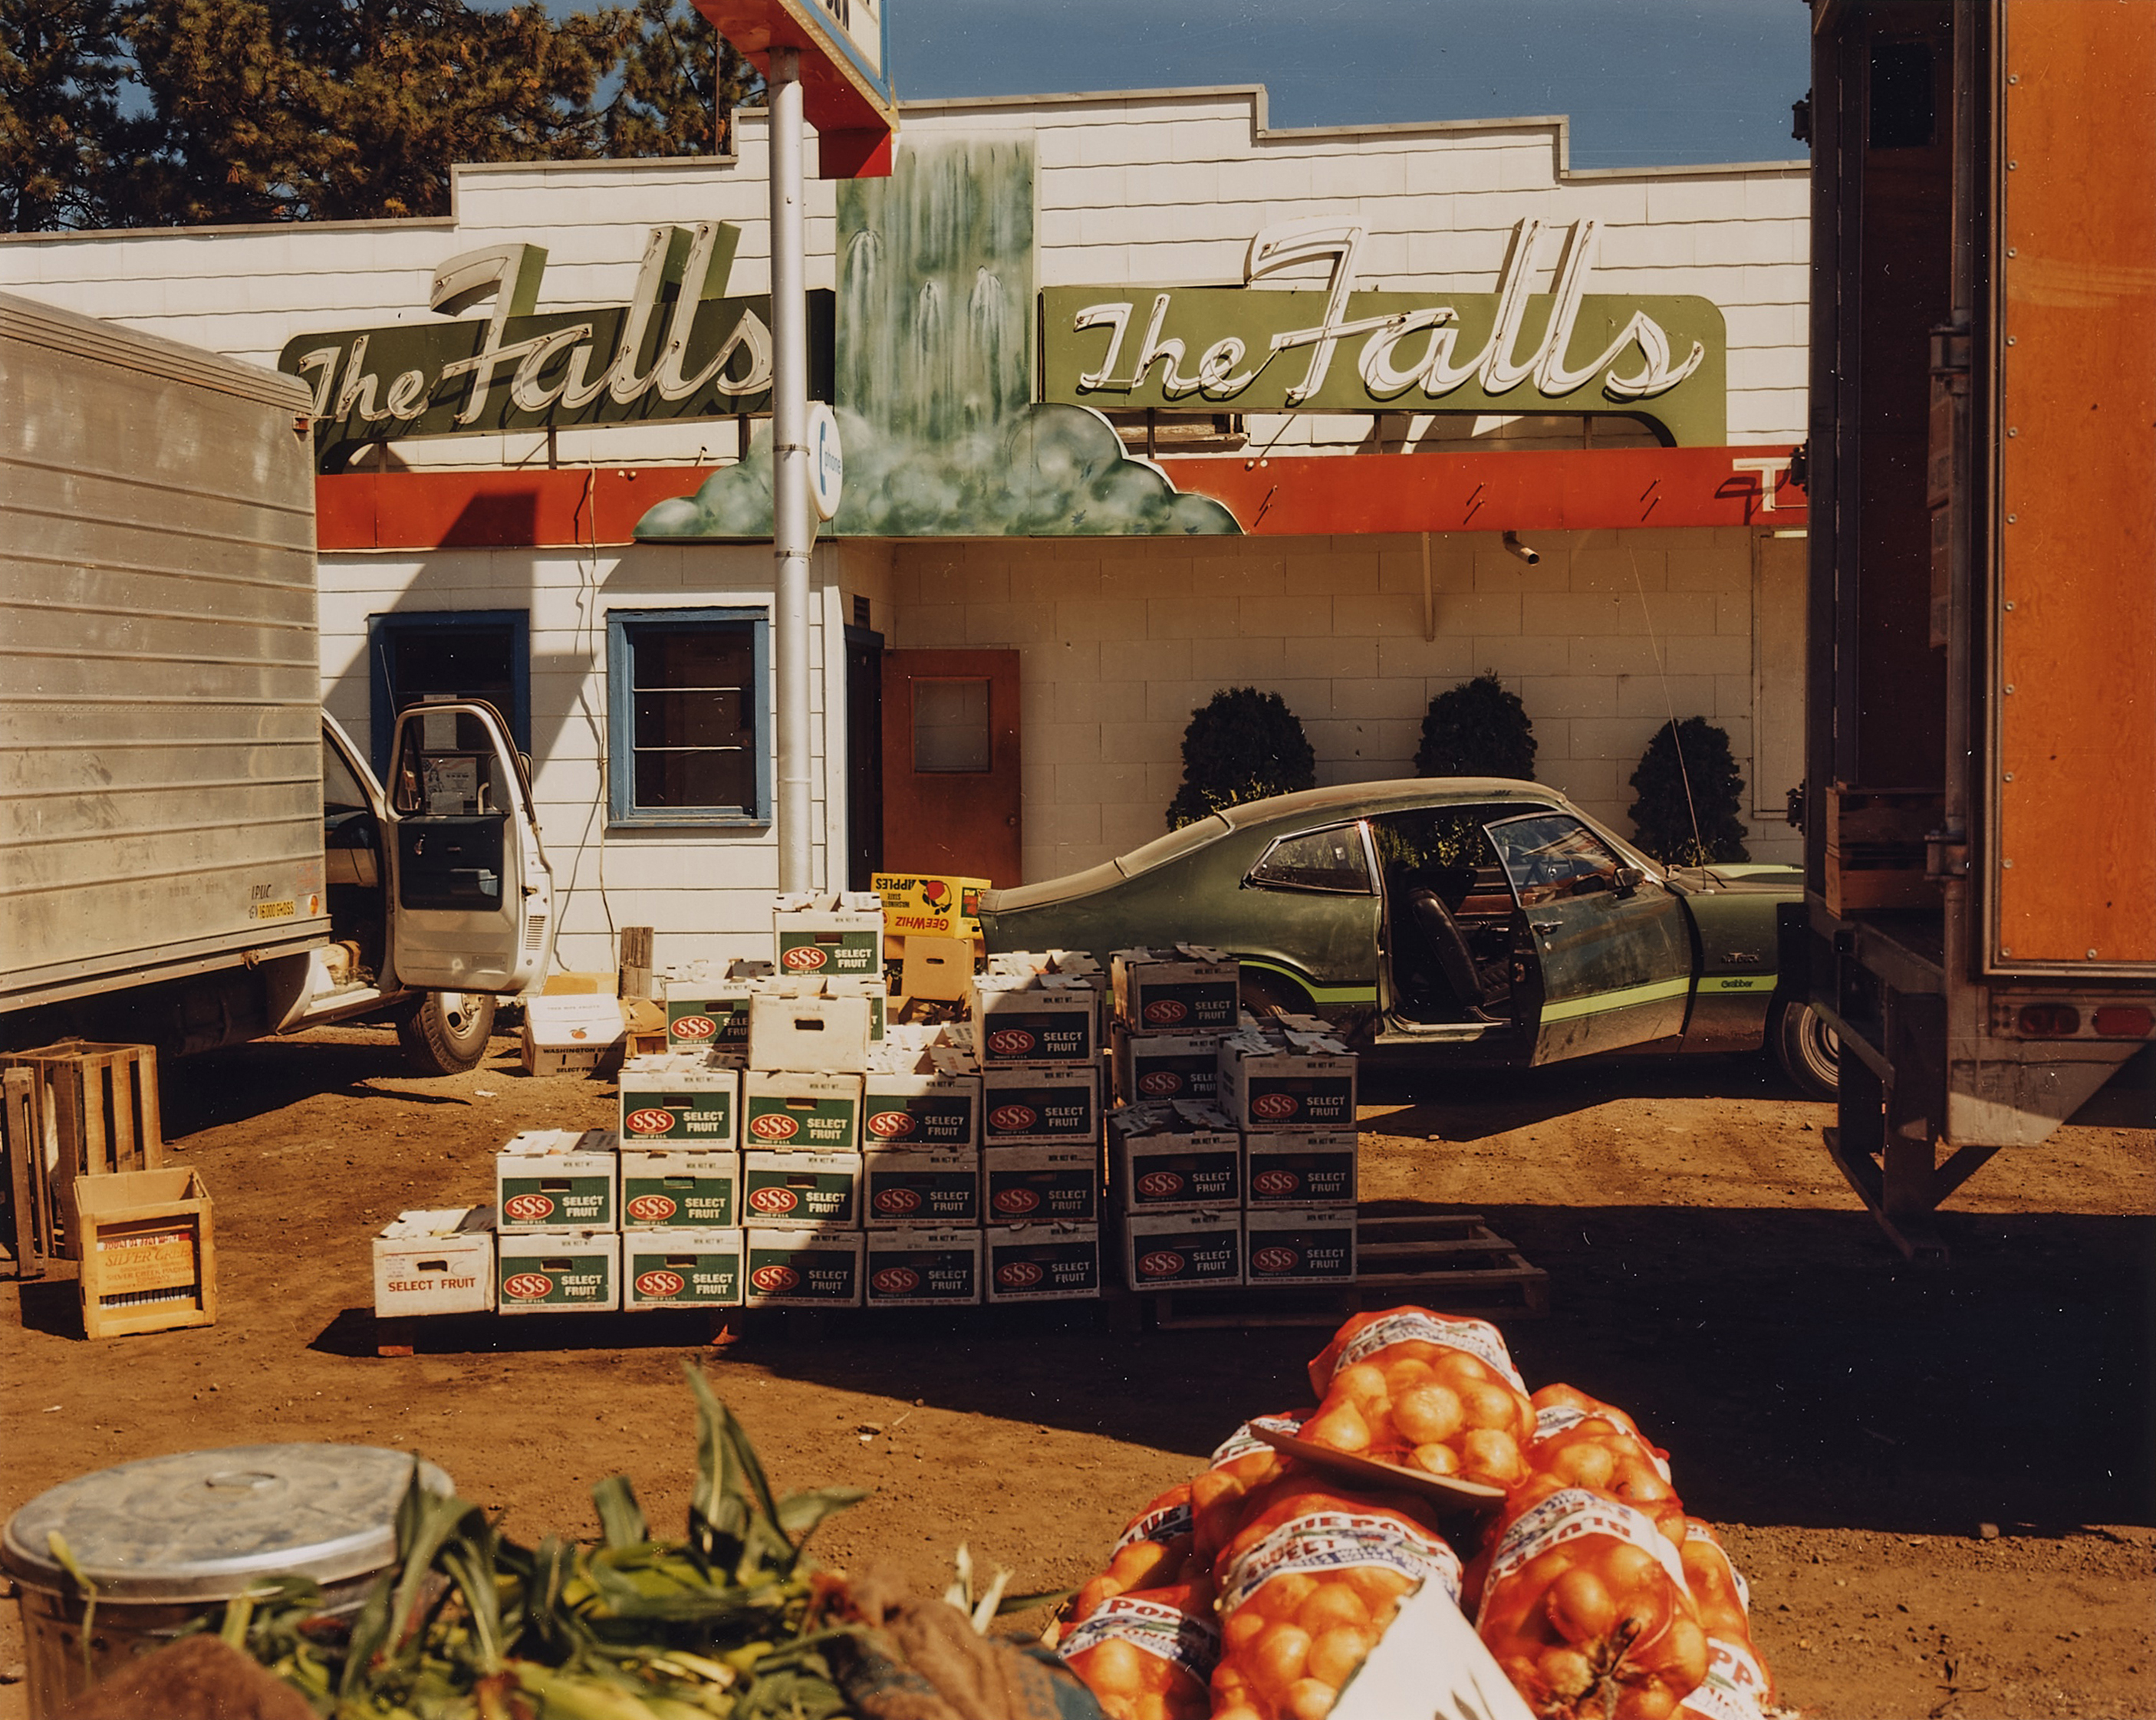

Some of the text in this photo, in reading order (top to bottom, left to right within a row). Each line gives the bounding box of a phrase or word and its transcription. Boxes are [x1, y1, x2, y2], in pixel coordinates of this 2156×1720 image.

[1075, 215, 1704, 403] The Falls
[299, 221, 772, 424] The Falls
[834, 949, 872, 958] SELECT
[838, 959, 867, 968] FRUIT
[1195, 1001, 1230, 1010] SELECT
[1198, 1011, 1226, 1020] FRUIT
[723, 1018, 749, 1026] SELE
[727, 1028, 748, 1036] FRU
[1043, 1032, 1082, 1041] SELECT
[1047, 1043, 1078, 1052] FRUIT
[1193, 1083, 1216, 1092] FRUI
[1306, 1097, 1345, 1105] SELECT
[683, 1111, 724, 1121] SELECT
[1045, 1107, 1084, 1116] SELECT
[1310, 1107, 1340, 1117] FRUIT
[807, 1118, 848, 1129] SELECT
[924, 1116, 964, 1125] SELECT
[1048, 1118, 1079, 1126] FRUIT
[686, 1123, 719, 1132] FRUIT
[928, 1126, 959, 1136] FRUIT
[810, 1129, 842, 1140] FRUIT
[1192, 1172, 1230, 1182] SELECT
[1308, 1172, 1345, 1182] SELECT
[1196, 1182, 1226, 1192] FRUIT
[1312, 1183, 1341, 1192] FRUIT
[805, 1192, 845, 1202] SELECT
[930, 1192, 969, 1201] SELECT
[1048, 1190, 1088, 1199] SELECT
[562, 1196, 604, 1206] SELECT
[685, 1198, 726, 1208] SELECT
[1052, 1201, 1082, 1210] FRUIT
[566, 1207, 598, 1217] FRUIT
[809, 1203, 840, 1213] FRUIT
[933, 1202, 964, 1212] FRUIT
[688, 1209, 720, 1218] FRUIT
[105, 1246, 191, 1267] SILVER CREE
[1193, 1250, 1231, 1261] SELECT
[1307, 1249, 1345, 1258] SELECT
[1052, 1261, 1090, 1272] SELECT
[1197, 1261, 1226, 1271] FRUIT
[1310, 1260, 1340, 1268] FRUIT
[693, 1274, 733, 1284] SELECT
[809, 1270, 848, 1280] SELECT
[928, 1270, 967, 1279] SELECT
[1055, 1273, 1085, 1283] FRUIT
[388, 1278, 476, 1292] SELECT FRUIT
[561, 1275, 602, 1285] SELECT
[696, 1284, 728, 1294] FRUIT
[812, 1281, 842, 1290] FRUIT
[932, 1281, 963, 1290] FRUIT
[565, 1286, 597, 1296] FRUIT
